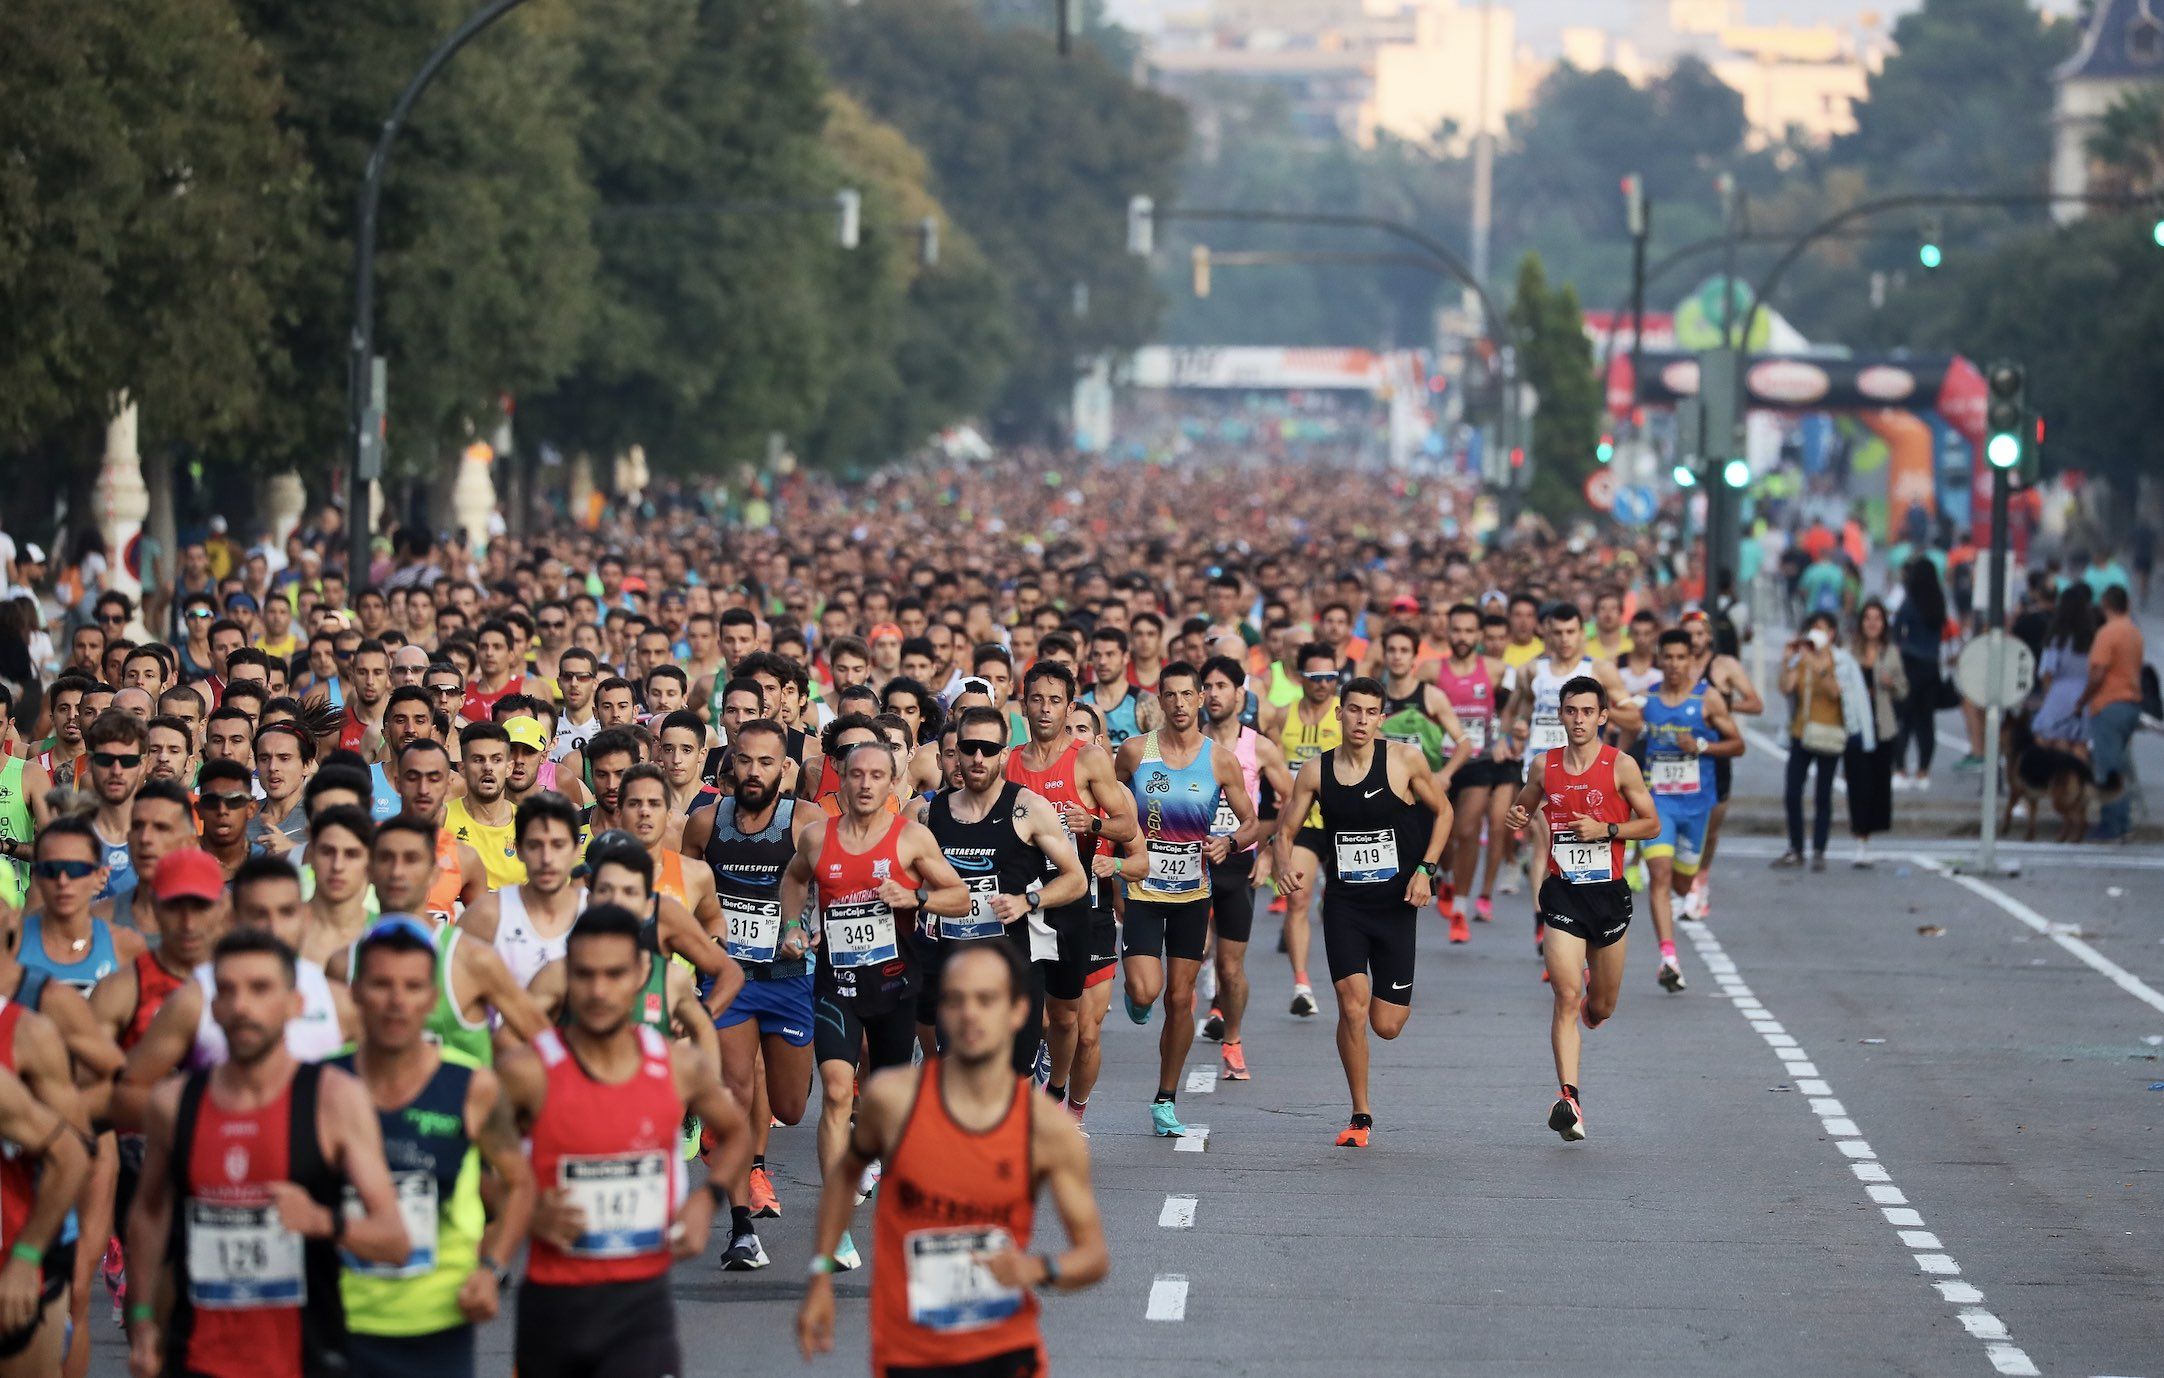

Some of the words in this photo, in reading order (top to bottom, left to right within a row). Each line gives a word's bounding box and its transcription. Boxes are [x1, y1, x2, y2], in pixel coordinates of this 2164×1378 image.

[1210, 812, 1235, 826] 75
[943, 848, 996, 856] METAESPORT
[1152, 842, 1182, 853] iberCaja
[1353, 848, 1380, 865] 419
[1569, 849, 1592, 865] 121
[722, 864, 779, 872] METAESPORT
[1160, 859, 1186, 875] 242
[722, 898, 756, 912] iberCaja
[831, 906, 866, 918] iberCaja
[731, 917, 760, 939] 315
[843, 924, 875, 945] 349
